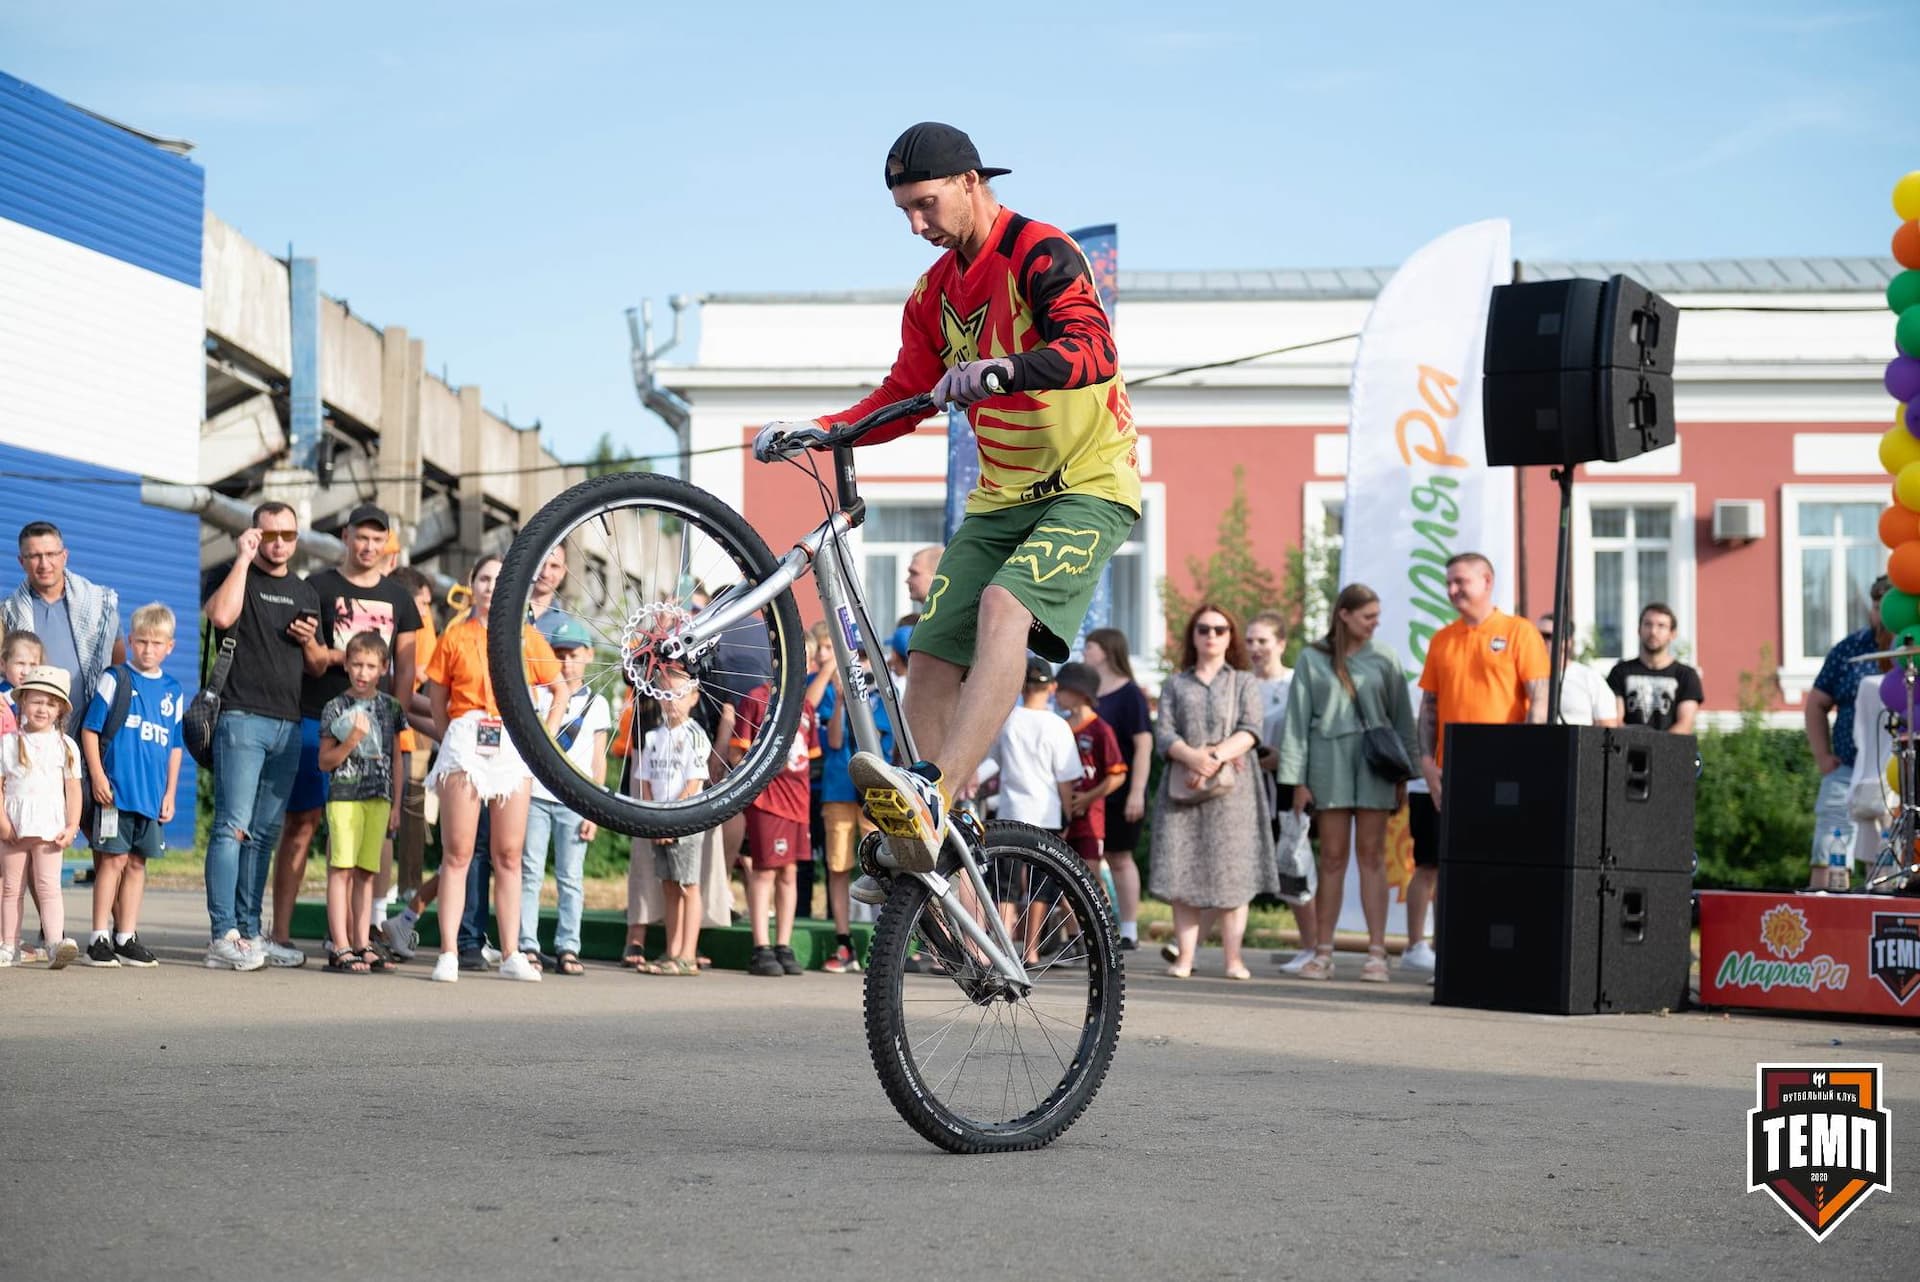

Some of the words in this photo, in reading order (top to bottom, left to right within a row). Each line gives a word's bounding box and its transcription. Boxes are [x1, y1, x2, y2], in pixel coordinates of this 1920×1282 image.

[848, 653, 869, 703] VANS
[140, 720, 169, 748] ВТБ
[750, 746, 779, 783] MICHELIN
[729, 780, 752, 799] Country
[1046, 846, 1082, 877] MICHELIN
[897, 1050, 924, 1099] MICHELIN
